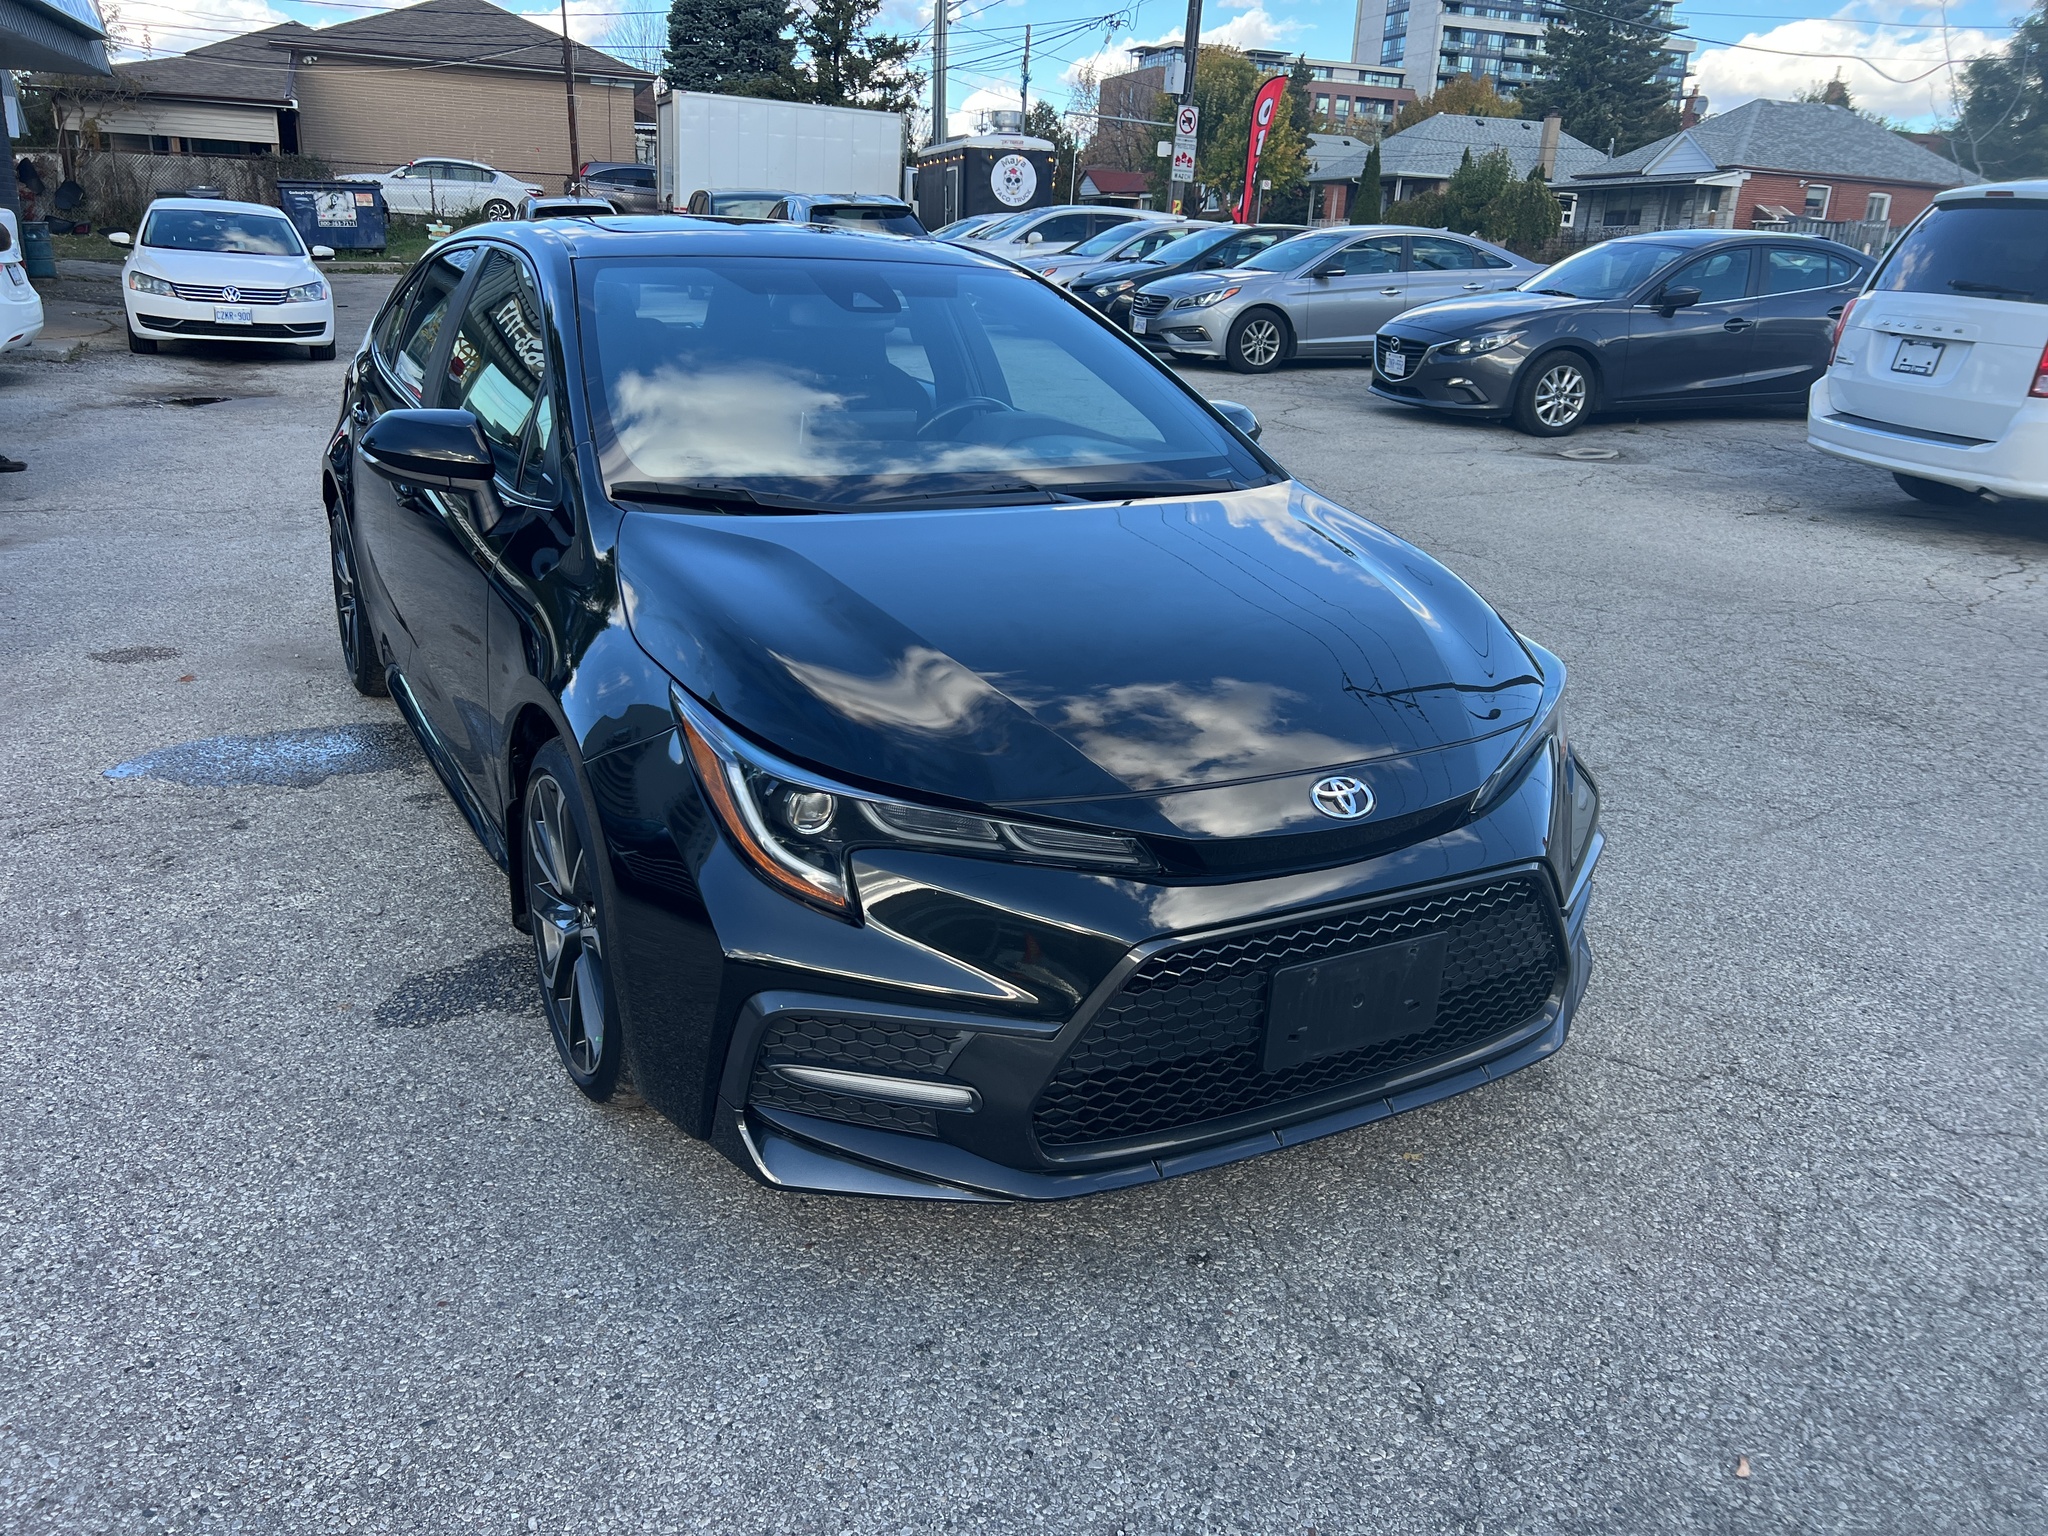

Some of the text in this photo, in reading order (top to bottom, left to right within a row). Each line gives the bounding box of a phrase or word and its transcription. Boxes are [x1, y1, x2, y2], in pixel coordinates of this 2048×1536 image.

[1000, 157, 1027, 168] Maya
[994, 187, 1033, 203] TACO TRUCK
